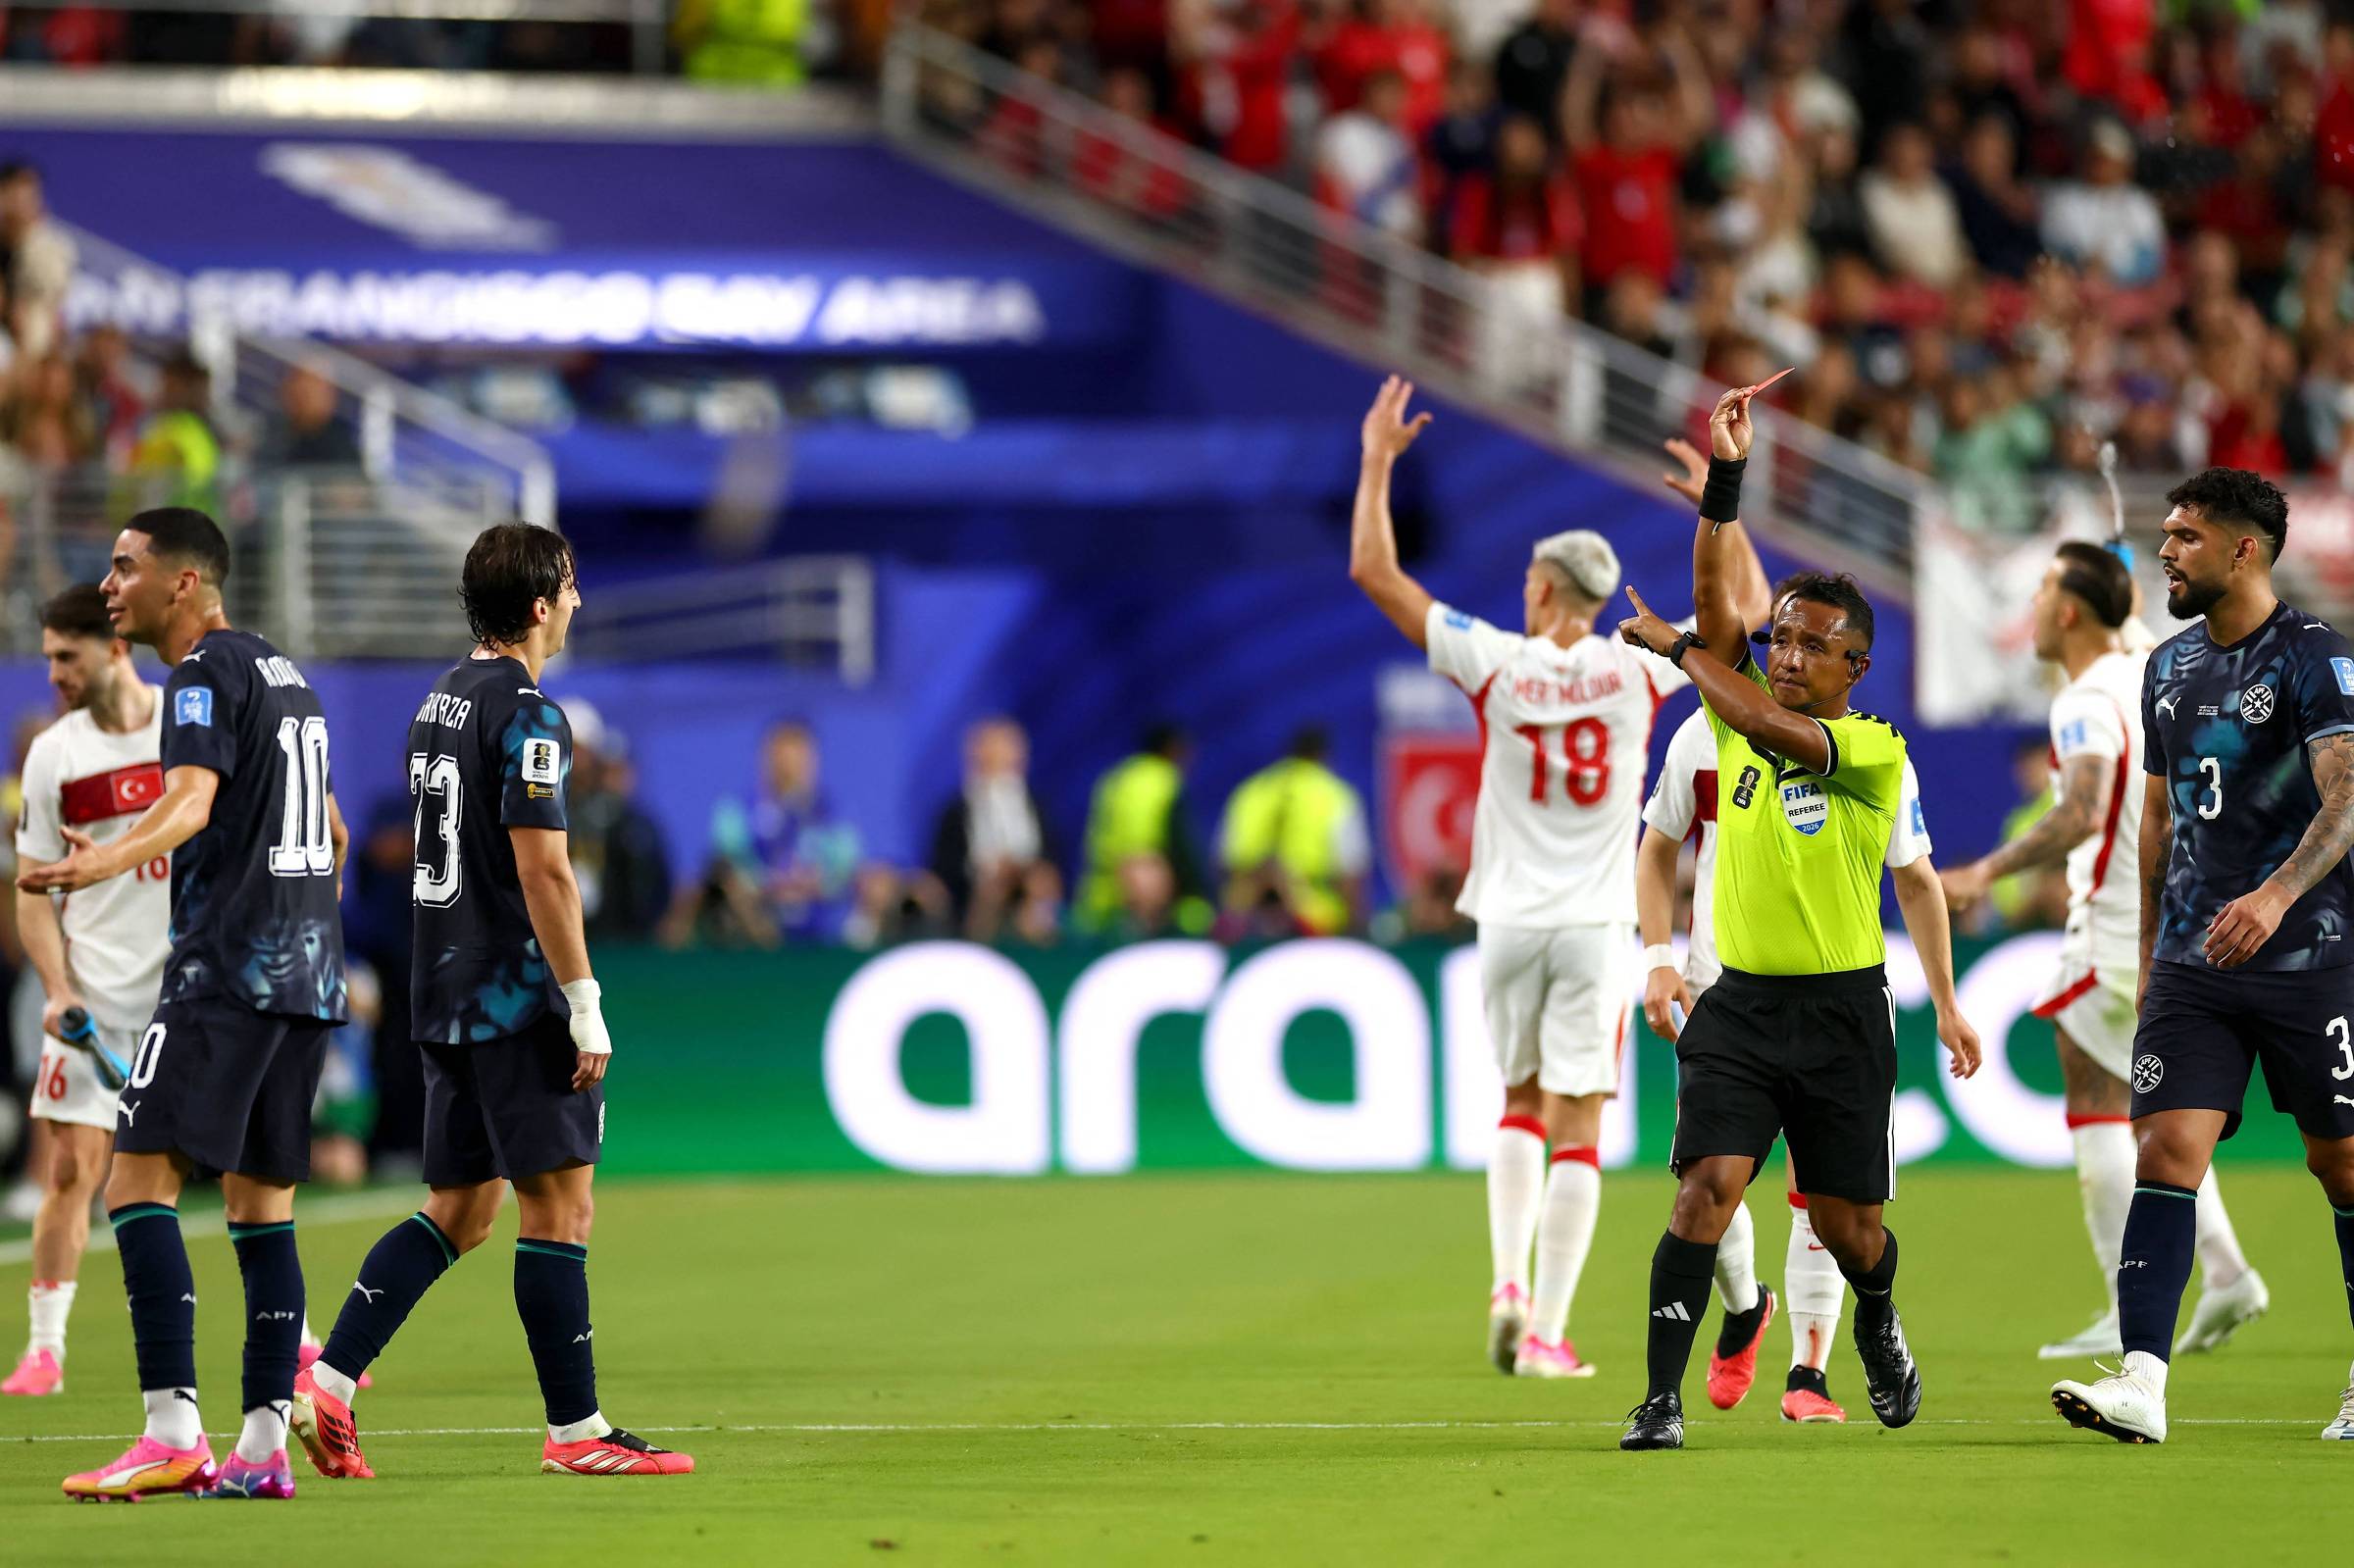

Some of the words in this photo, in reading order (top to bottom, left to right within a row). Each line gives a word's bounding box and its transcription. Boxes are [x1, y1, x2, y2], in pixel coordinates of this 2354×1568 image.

[1513, 717, 1610, 807] 18
[1784, 783, 1822, 801] FIFA
[2198, 757, 2223, 820] 3
[269, 717, 334, 876] 10
[1788, 803, 1825, 817] REFEREE
[1802, 822, 1819, 833] 2026
[37, 1054, 67, 1102] 16
[823, 938, 2072, 1175] arao
[2326, 1016, 2354, 1081] 3
